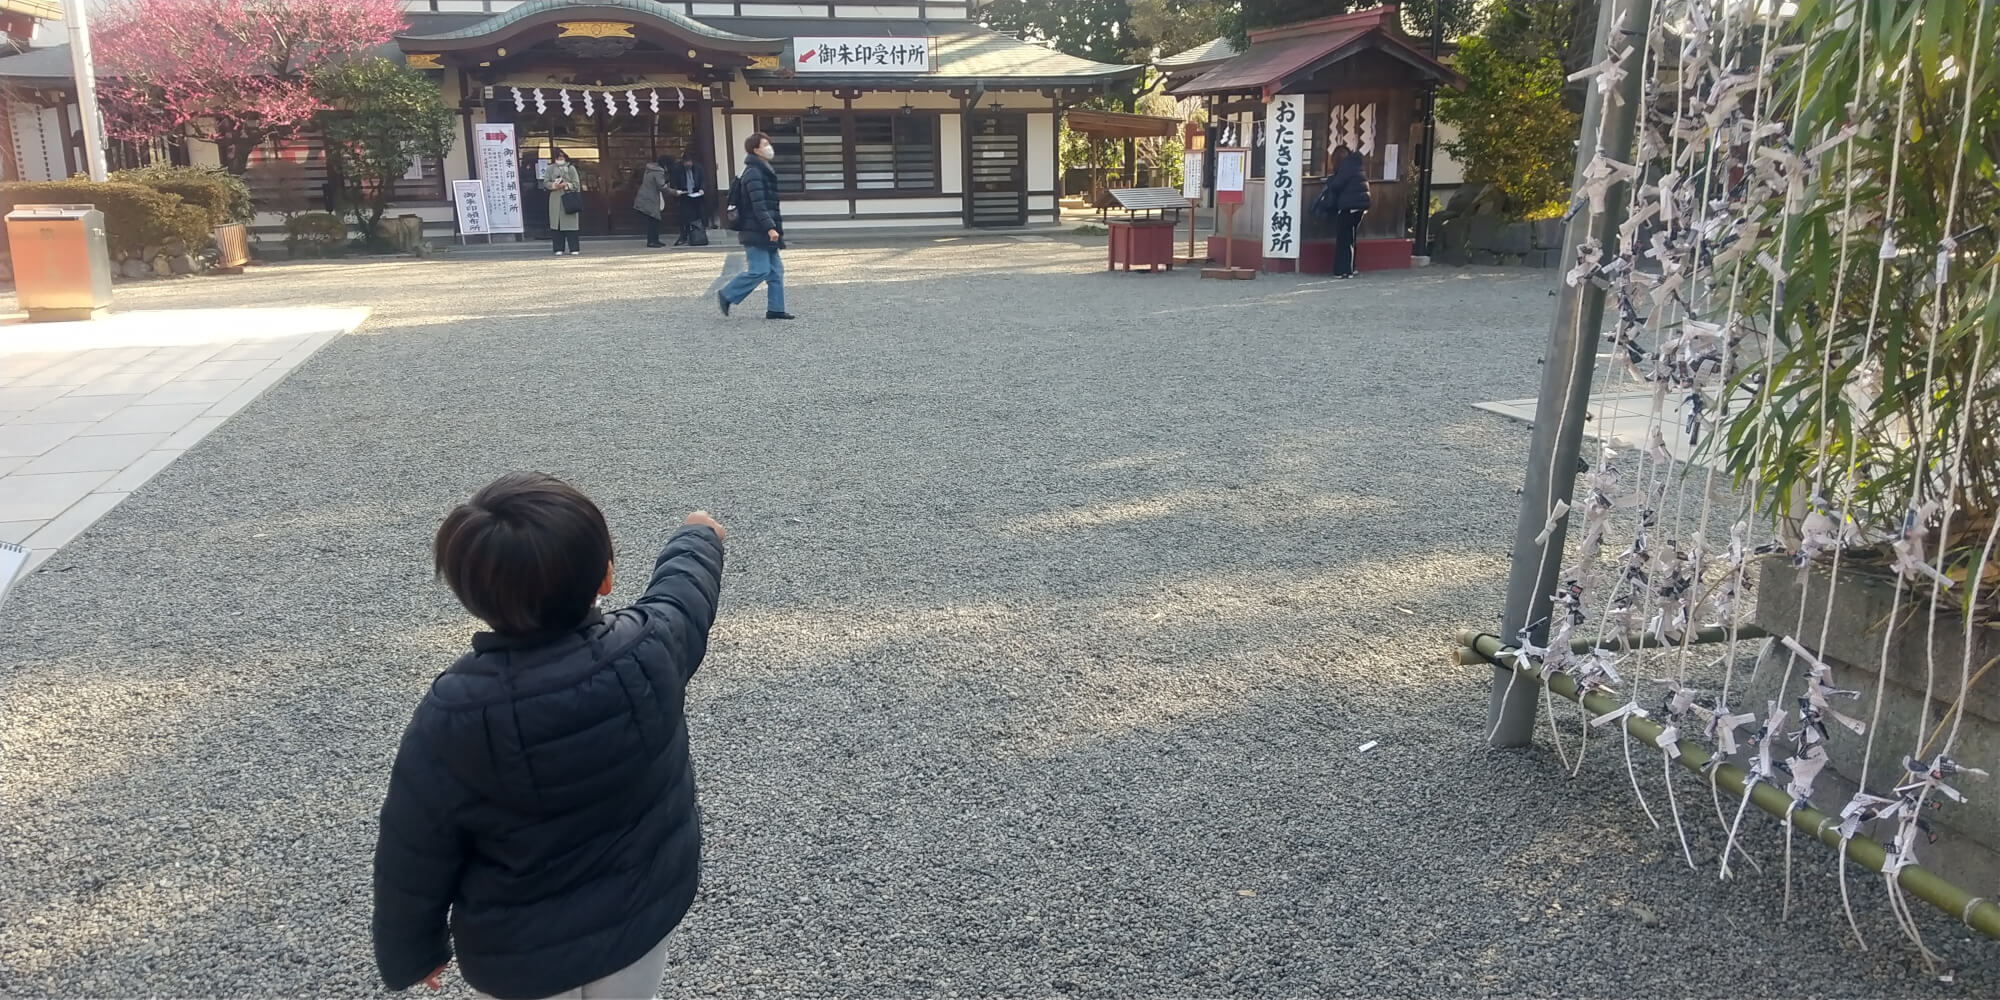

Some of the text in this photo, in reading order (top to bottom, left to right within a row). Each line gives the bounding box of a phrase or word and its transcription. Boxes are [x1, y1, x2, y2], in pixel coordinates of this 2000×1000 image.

[818, 43, 925, 66] 御朱印受付所
[1270, 100, 1296, 254] おたきあげ納所
